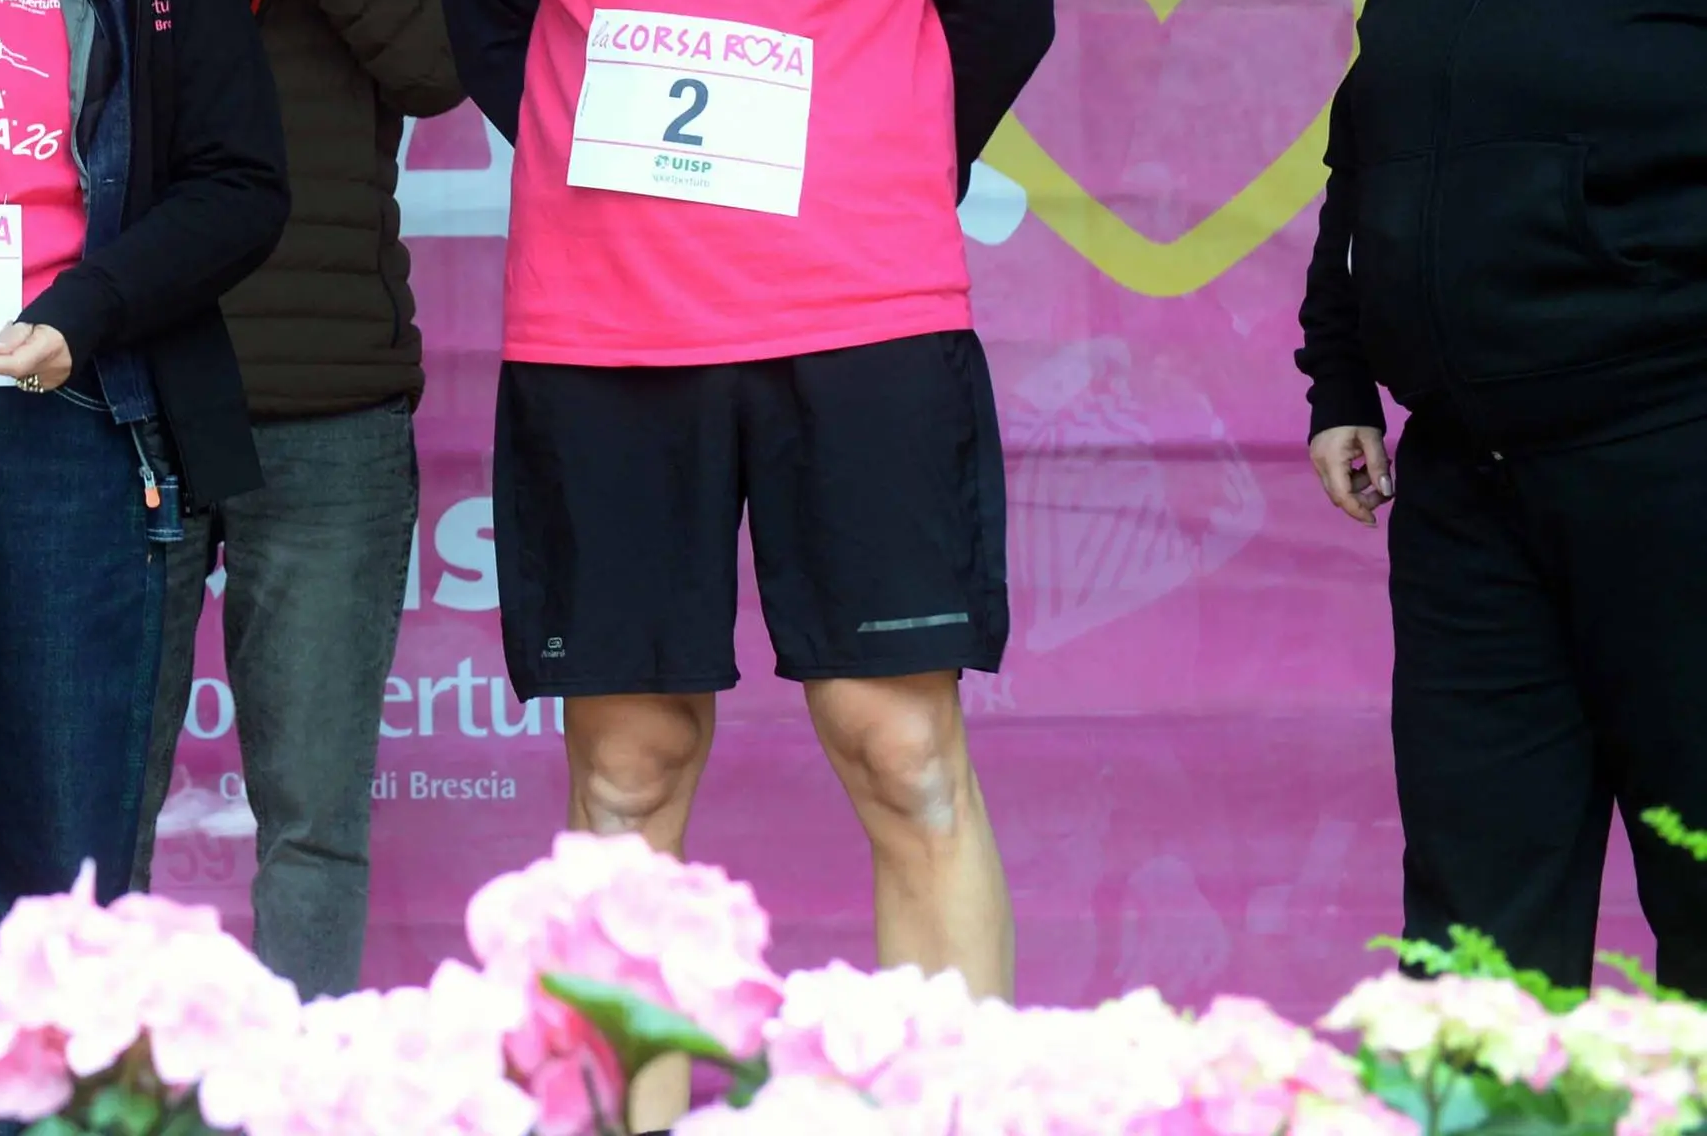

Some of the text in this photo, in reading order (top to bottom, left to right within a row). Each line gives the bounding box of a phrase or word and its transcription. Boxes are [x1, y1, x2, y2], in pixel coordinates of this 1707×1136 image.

[612, 23, 712, 60] CORSA
[662, 77, 710, 147] 2
[12, 123, 63, 161] 26
[672, 156, 713, 174] UISP
[409, 770, 516, 800] Brescia
